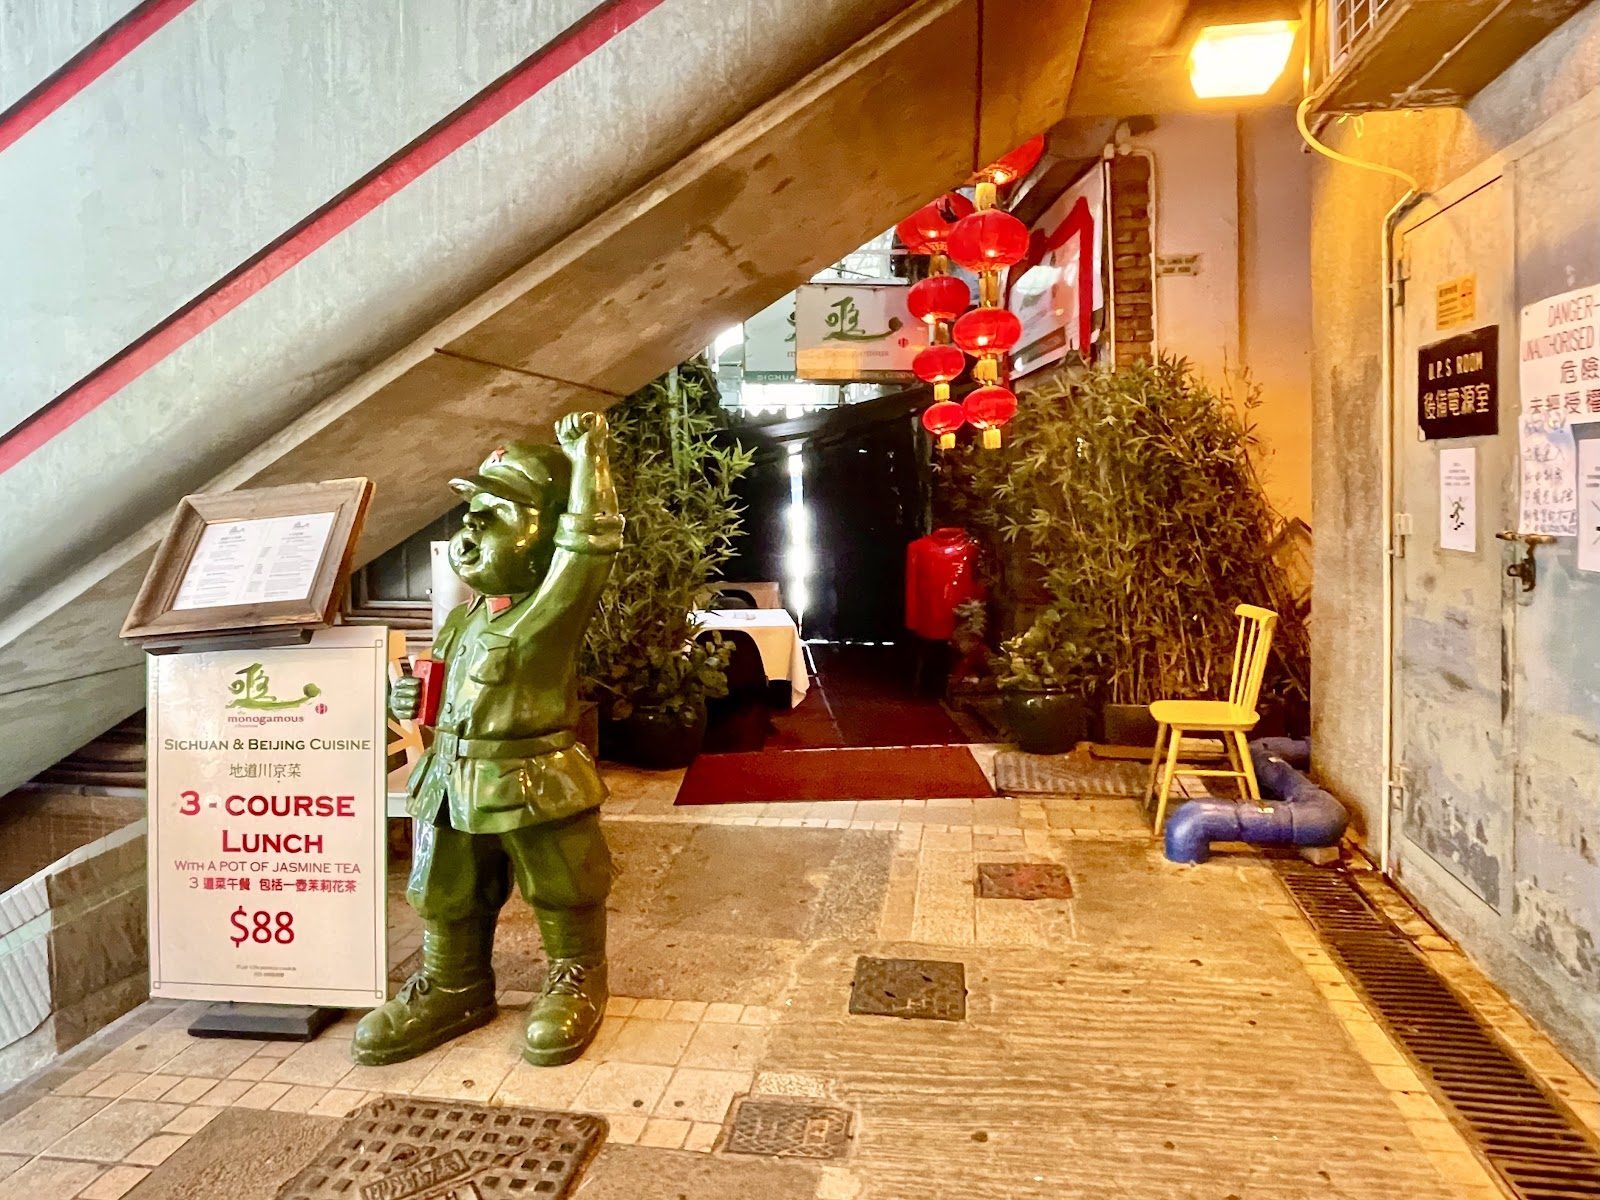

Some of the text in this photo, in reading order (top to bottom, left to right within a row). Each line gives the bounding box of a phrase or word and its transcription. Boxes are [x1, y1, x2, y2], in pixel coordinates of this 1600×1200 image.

[1547, 294, 1593, 328] DANGER
[1456, 351, 1483, 375] ROOM
[227, 715, 305, 726] monogamous
[164, 738, 371, 751] SICHUAN & BEIJING CUISINE
[229, 763, 302, 779] 地道川京菜
[179, 790, 201, 816] 3
[224, 794, 356, 817] COURSE
[222, 829, 324, 854] LUNCH
[207, 860, 217, 872] A
[219, 861, 248, 873] POT
[250, 861, 270, 873] OF
[272, 862, 331, 874] JASMINE
[334, 863, 361, 874] TEA
[188, 877, 199, 889] 3
[203, 878, 251, 891] 道菜午餐
[230, 905, 295, 949] $88
